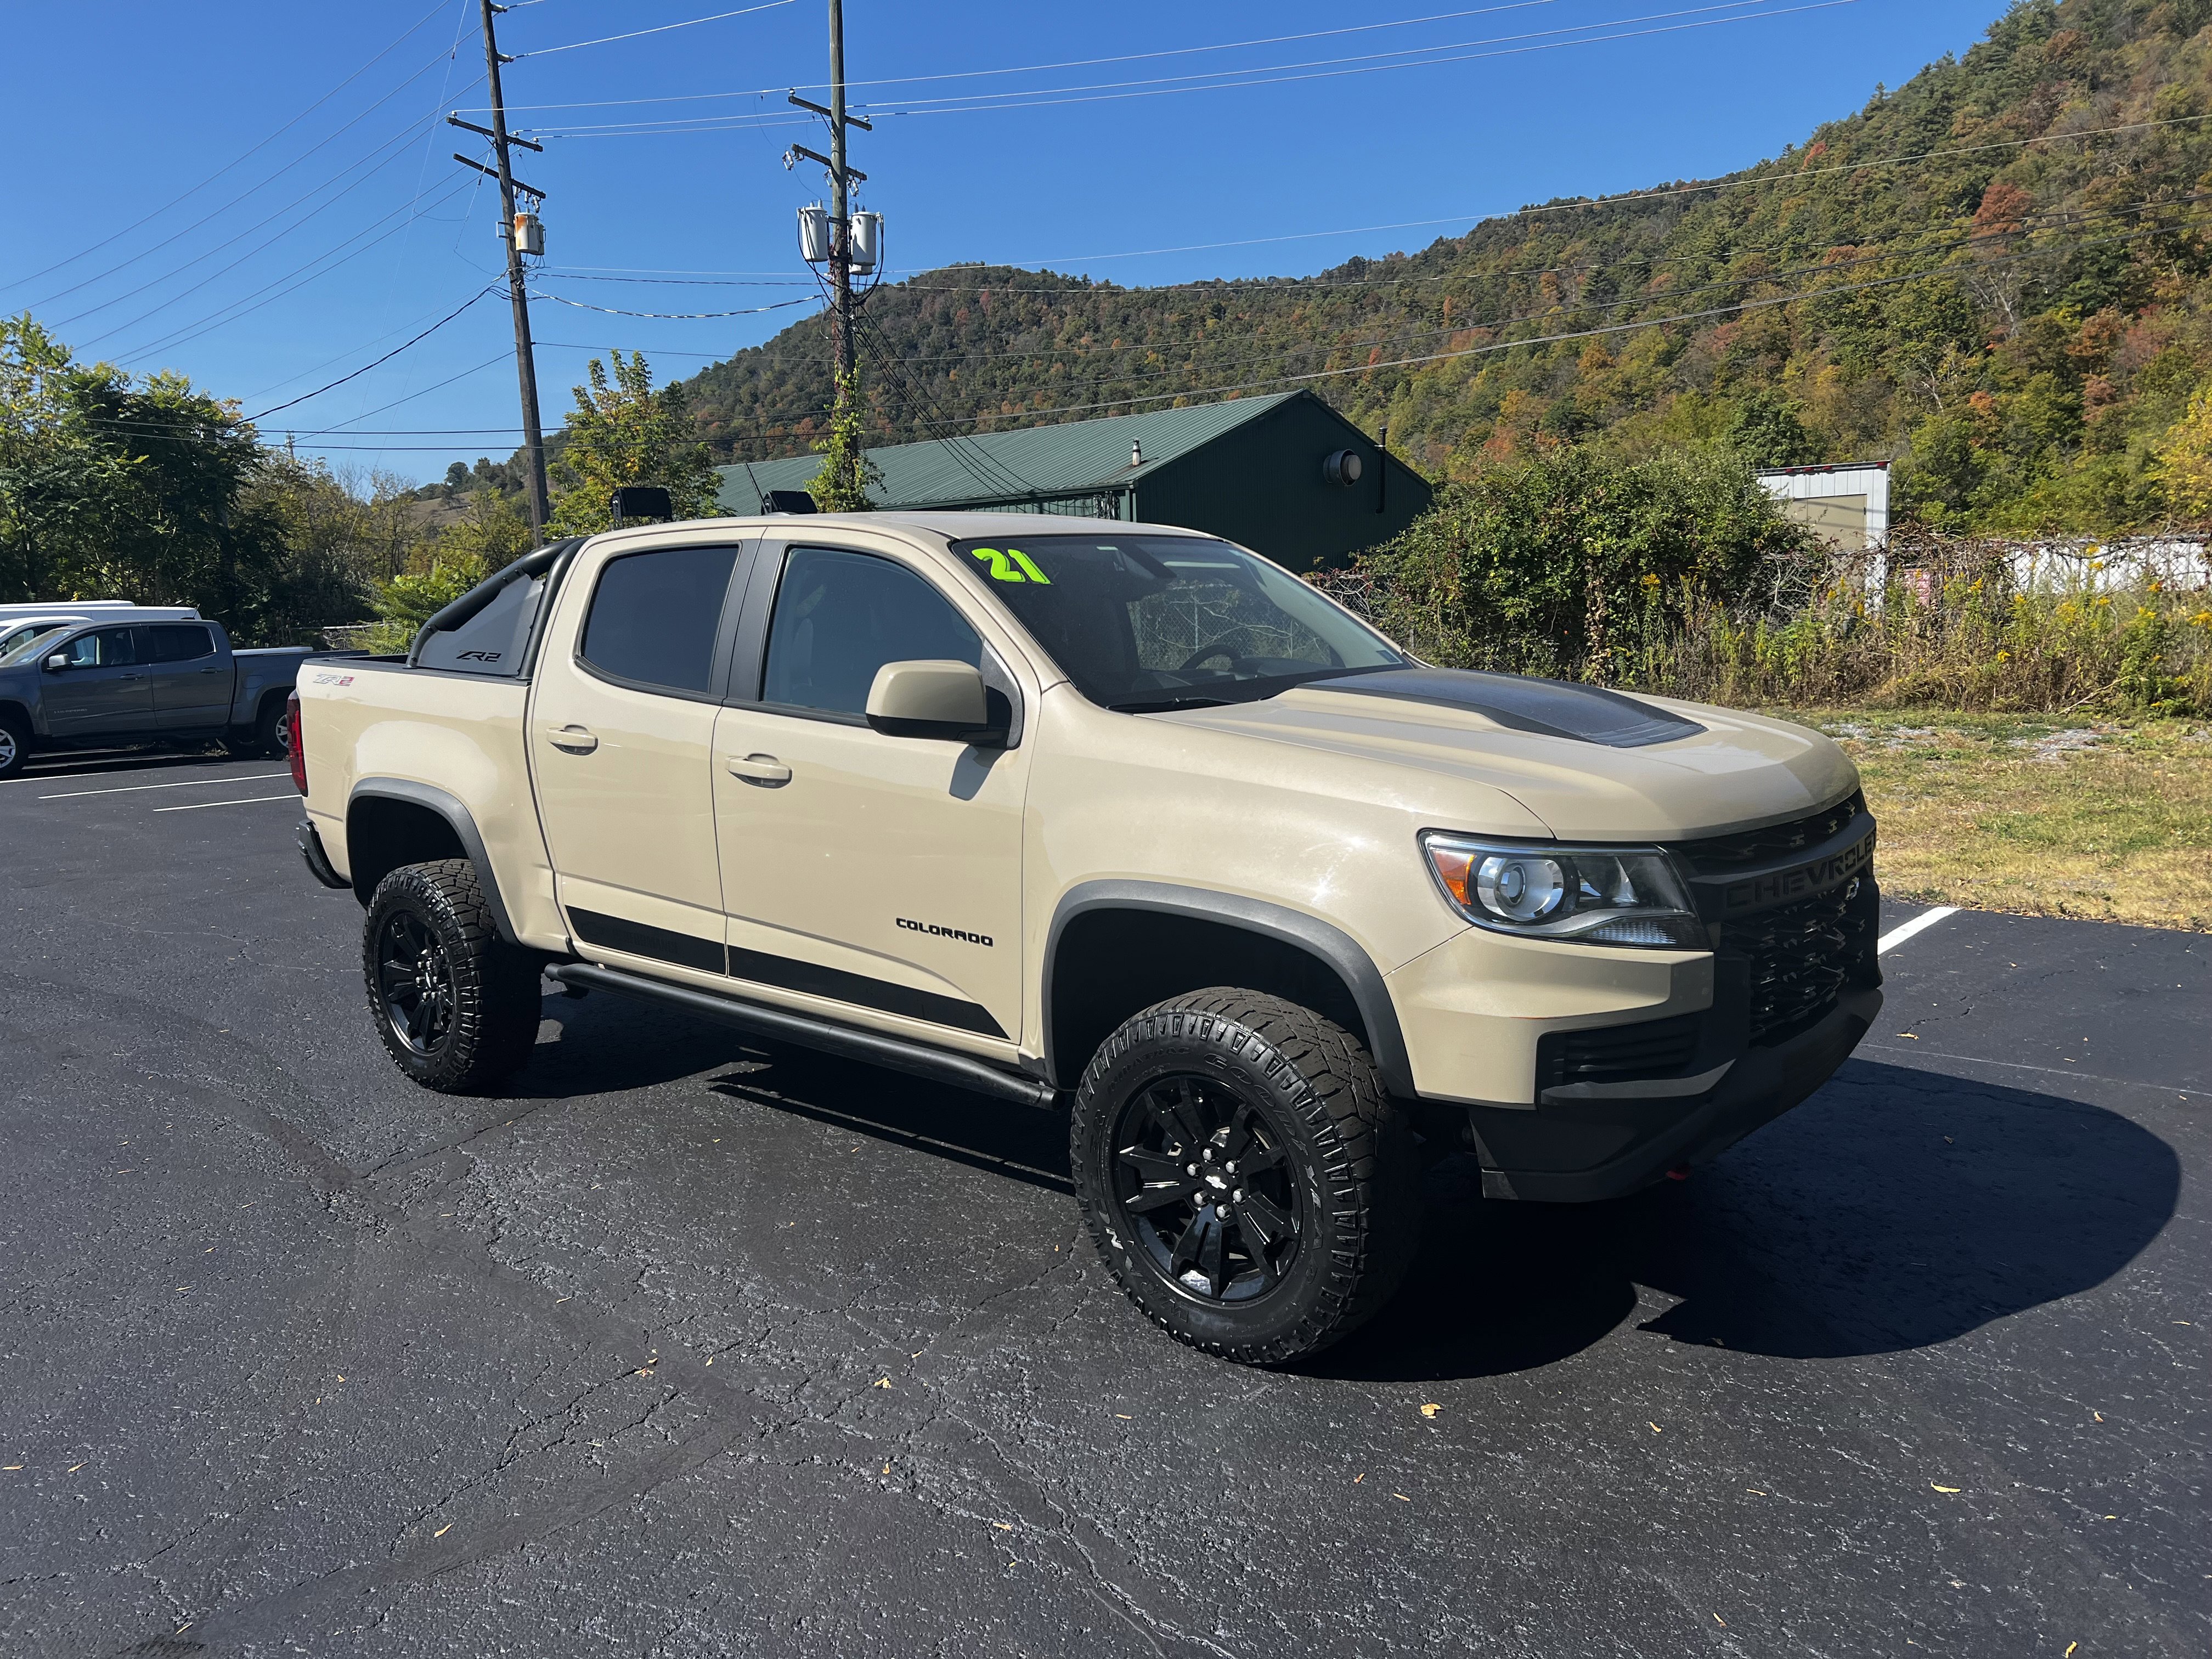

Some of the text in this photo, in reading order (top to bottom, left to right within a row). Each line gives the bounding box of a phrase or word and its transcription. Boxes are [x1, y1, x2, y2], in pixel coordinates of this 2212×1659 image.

[971, 548, 1051, 585] 21
[456, 650, 502, 662] ZR2
[313, 673, 355, 686] ZR2
[896, 917, 994, 947] COLORADO
